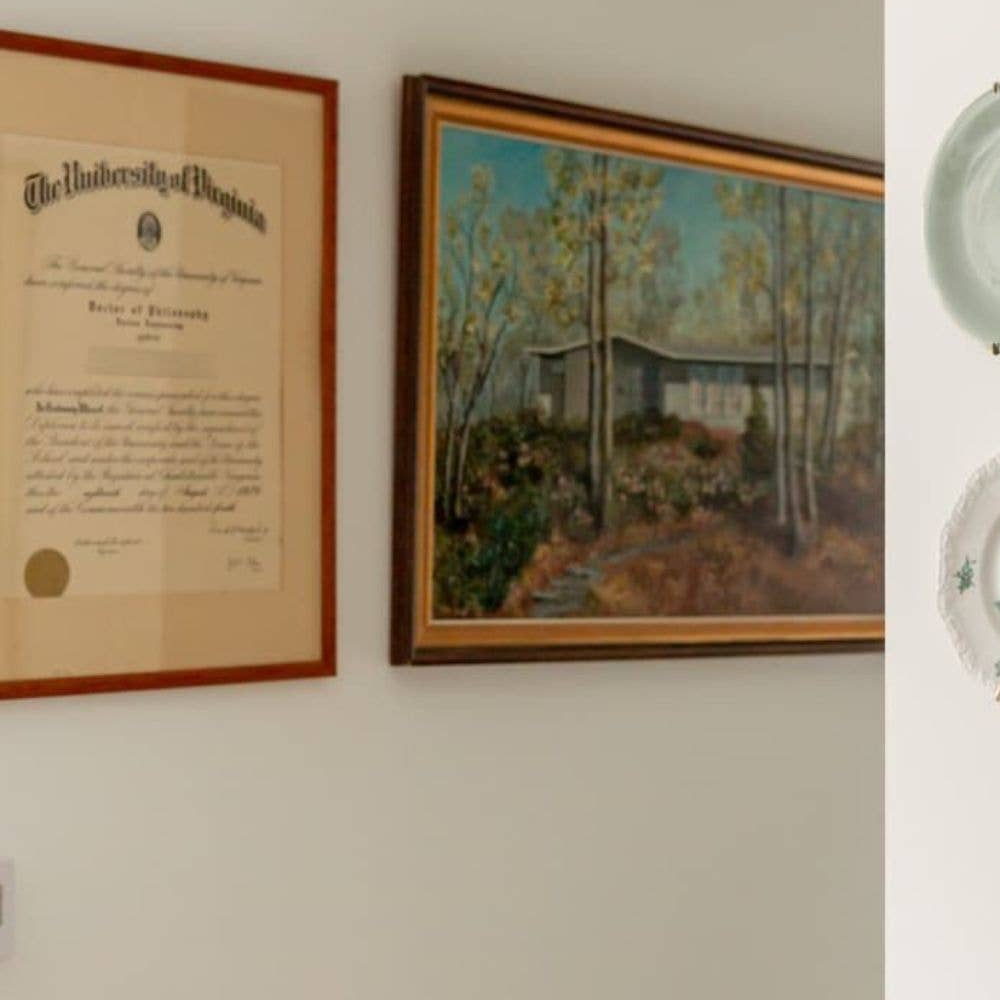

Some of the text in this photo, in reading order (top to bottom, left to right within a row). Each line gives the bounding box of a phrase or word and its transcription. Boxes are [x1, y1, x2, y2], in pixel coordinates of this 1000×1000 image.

[24, 159, 266, 234] The University of Virginia
